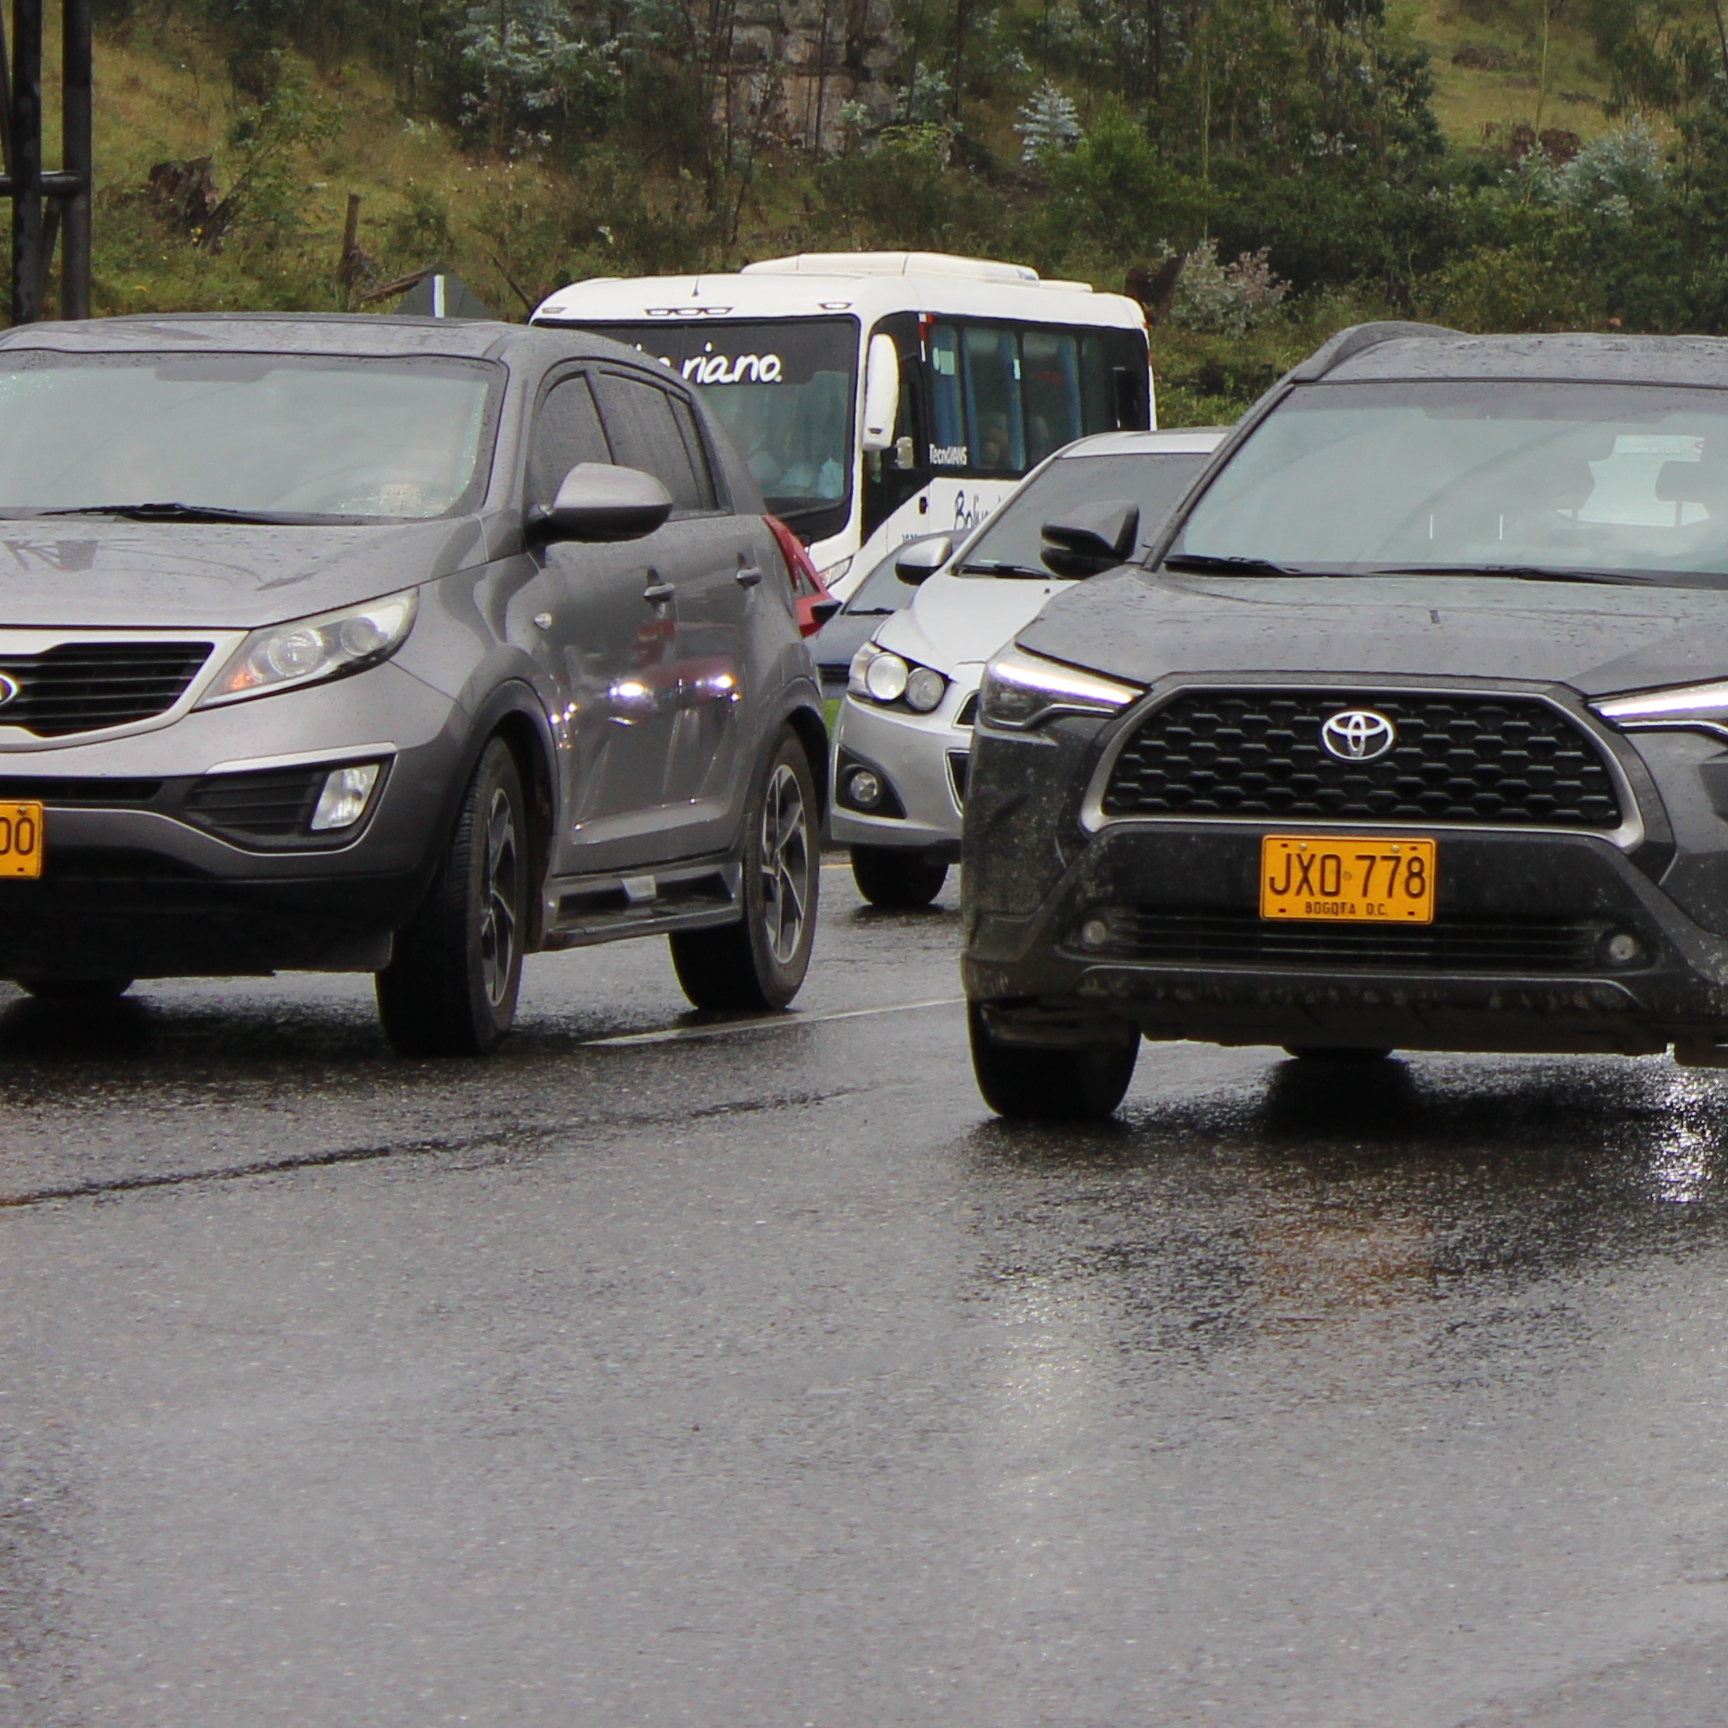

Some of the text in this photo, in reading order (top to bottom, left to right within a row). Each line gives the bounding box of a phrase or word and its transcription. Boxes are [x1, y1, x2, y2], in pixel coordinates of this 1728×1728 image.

[658, 341, 782, 384] riano.
[1269, 853, 1426, 899] JXO 778
